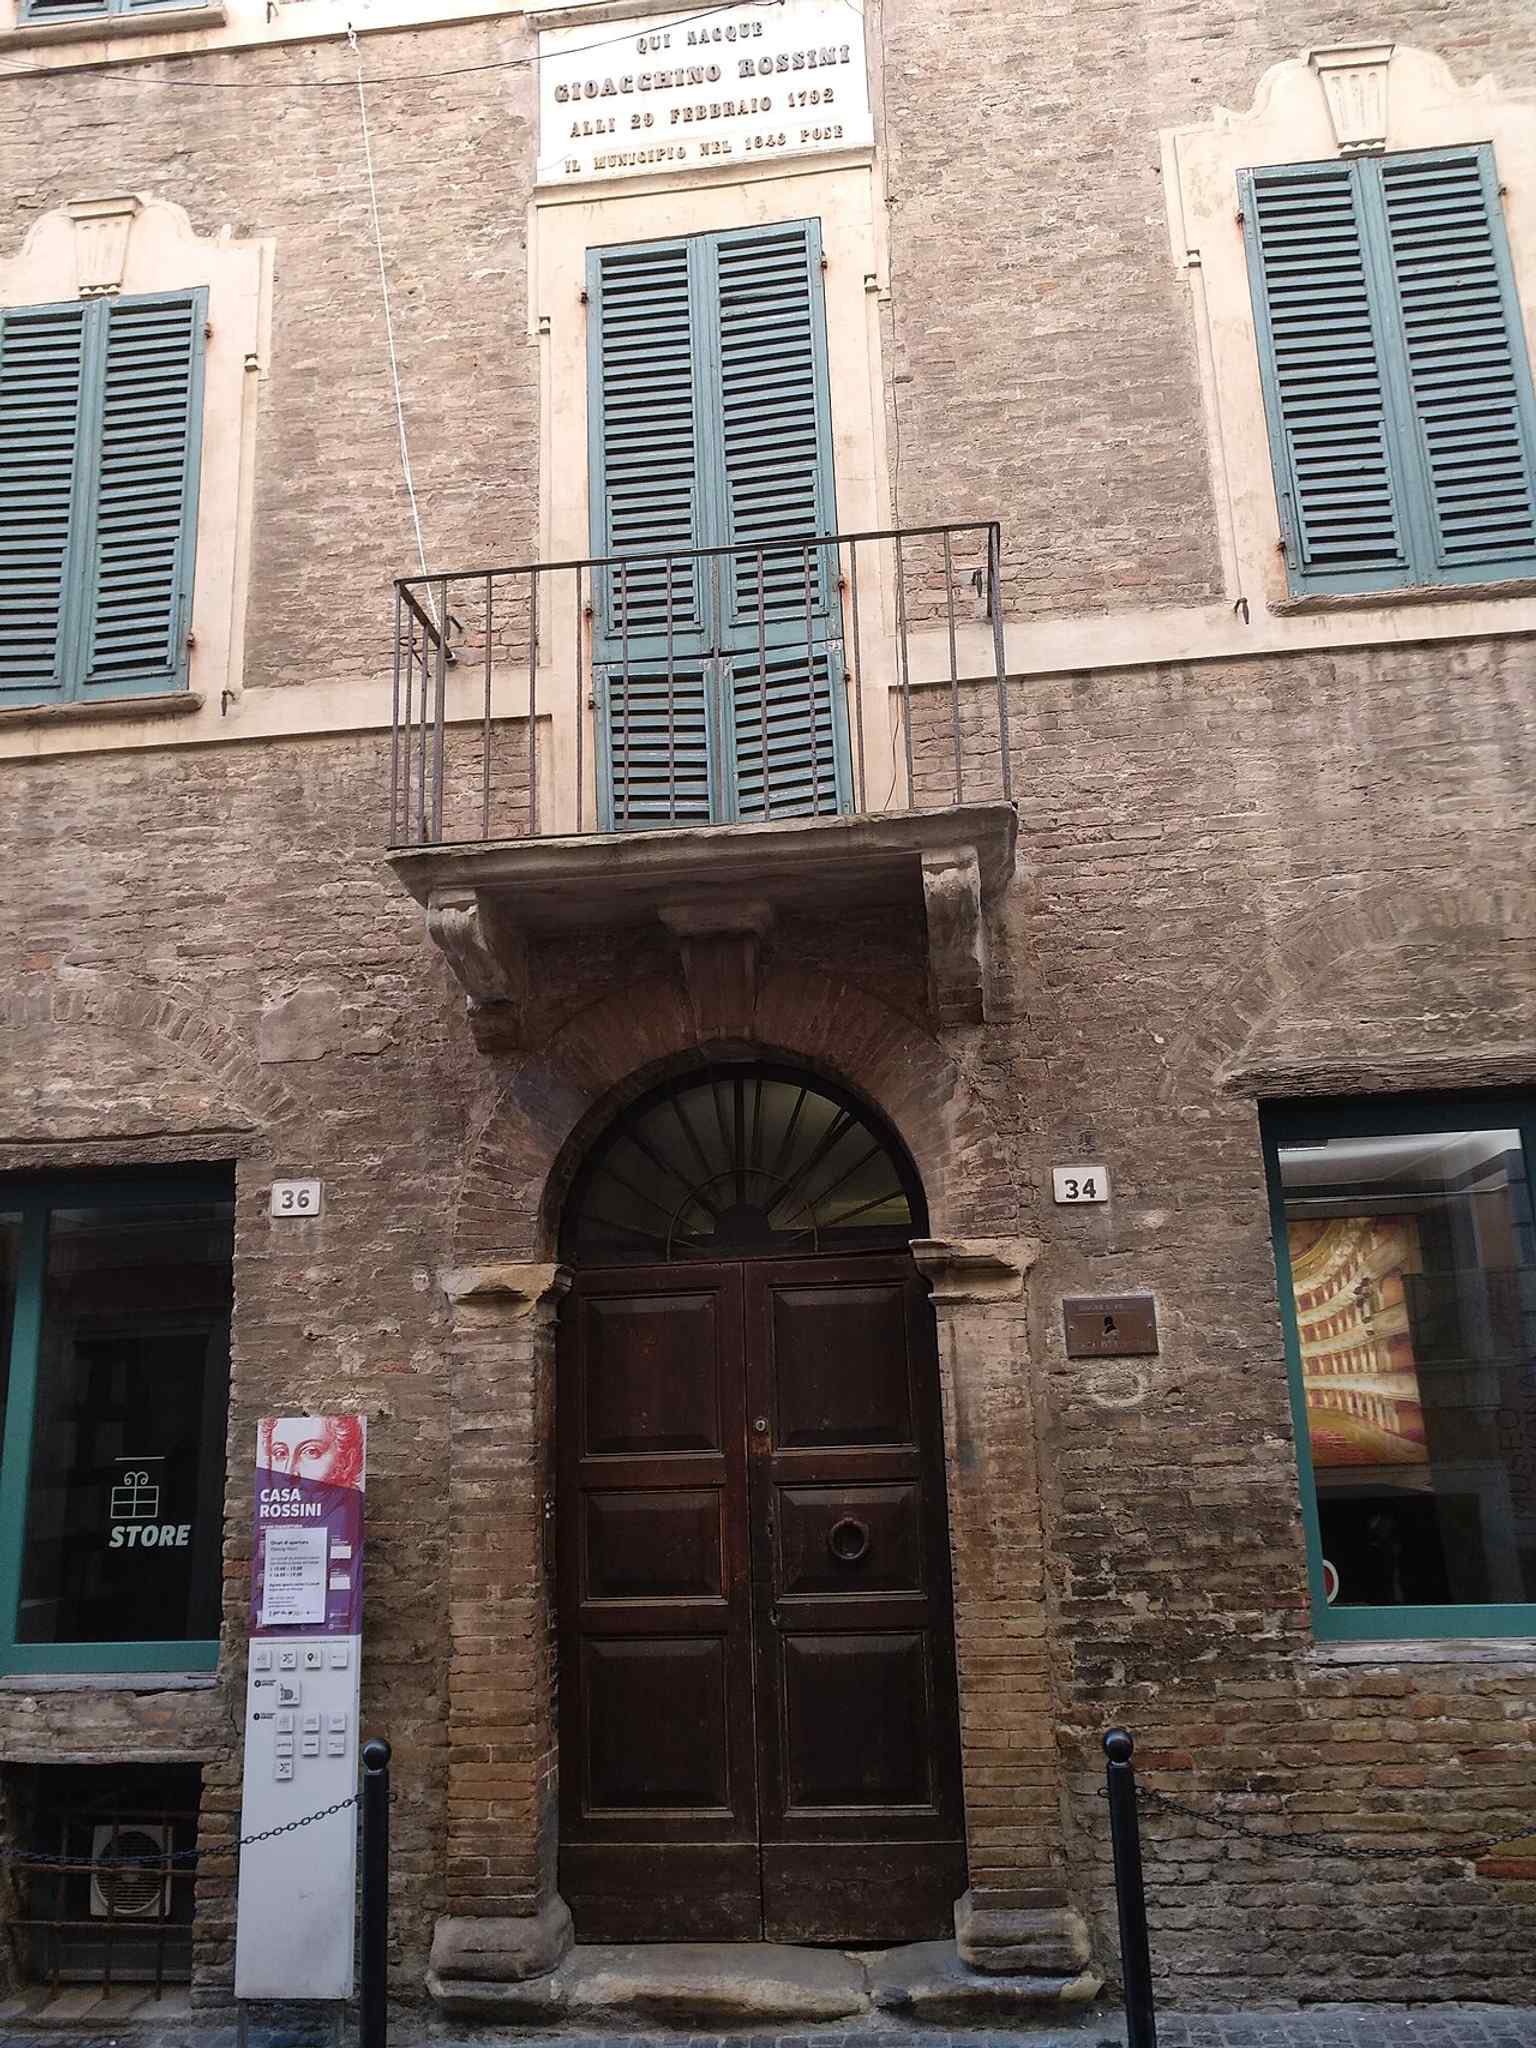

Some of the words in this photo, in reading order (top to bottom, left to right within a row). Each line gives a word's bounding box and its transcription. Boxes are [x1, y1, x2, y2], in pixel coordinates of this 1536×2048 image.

[635, 34, 672, 55] QUI
[686, 21, 764, 46] NACQUE
[554, 64, 722, 103] GIOACCHINO
[738, 44, 850, 79] ROSSINI
[570, 117, 616, 138] ALLI
[630, 112, 655, 130] 29
[670, 96, 772, 126] FEBBRAIO
[788, 87, 835, 108] 1792
[564, 159, 581, 174] IL
[594, 147, 687, 170] MUNICIPIO
[699, 141, 733, 157] NEL
[800, 125, 844, 143] POSE
[281, 1189, 310, 1209] 36
[1064, 1178, 1097, 1199] 34
[260, 1488, 301, 1502] CASA
[260, 1503, 321, 1517] ROSSINI
[108, 1524, 191, 1548] STORE
